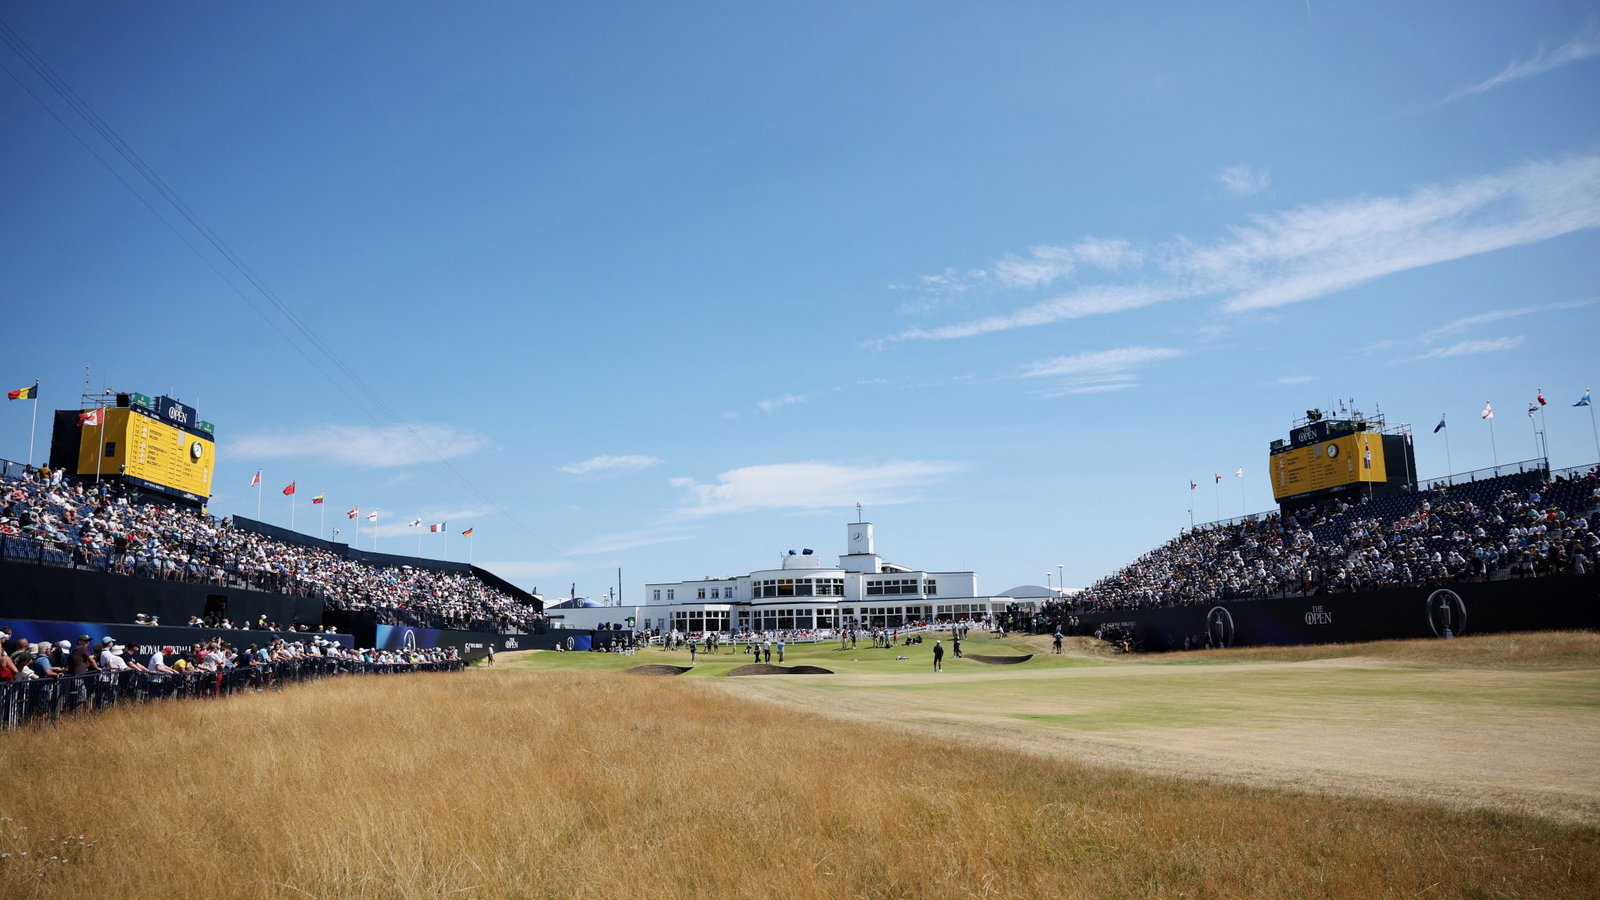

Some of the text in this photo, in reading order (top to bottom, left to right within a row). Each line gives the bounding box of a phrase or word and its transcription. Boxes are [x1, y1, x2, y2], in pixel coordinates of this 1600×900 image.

[168, 406, 188, 424] OPEN
[1298, 429, 1318, 442] OPEN
[1312, 605, 1324, 613] THE
[1305, 611, 1332, 625] OPEN
[139, 645, 161, 655] ROYAL
[504, 640, 519, 649] OPEN
